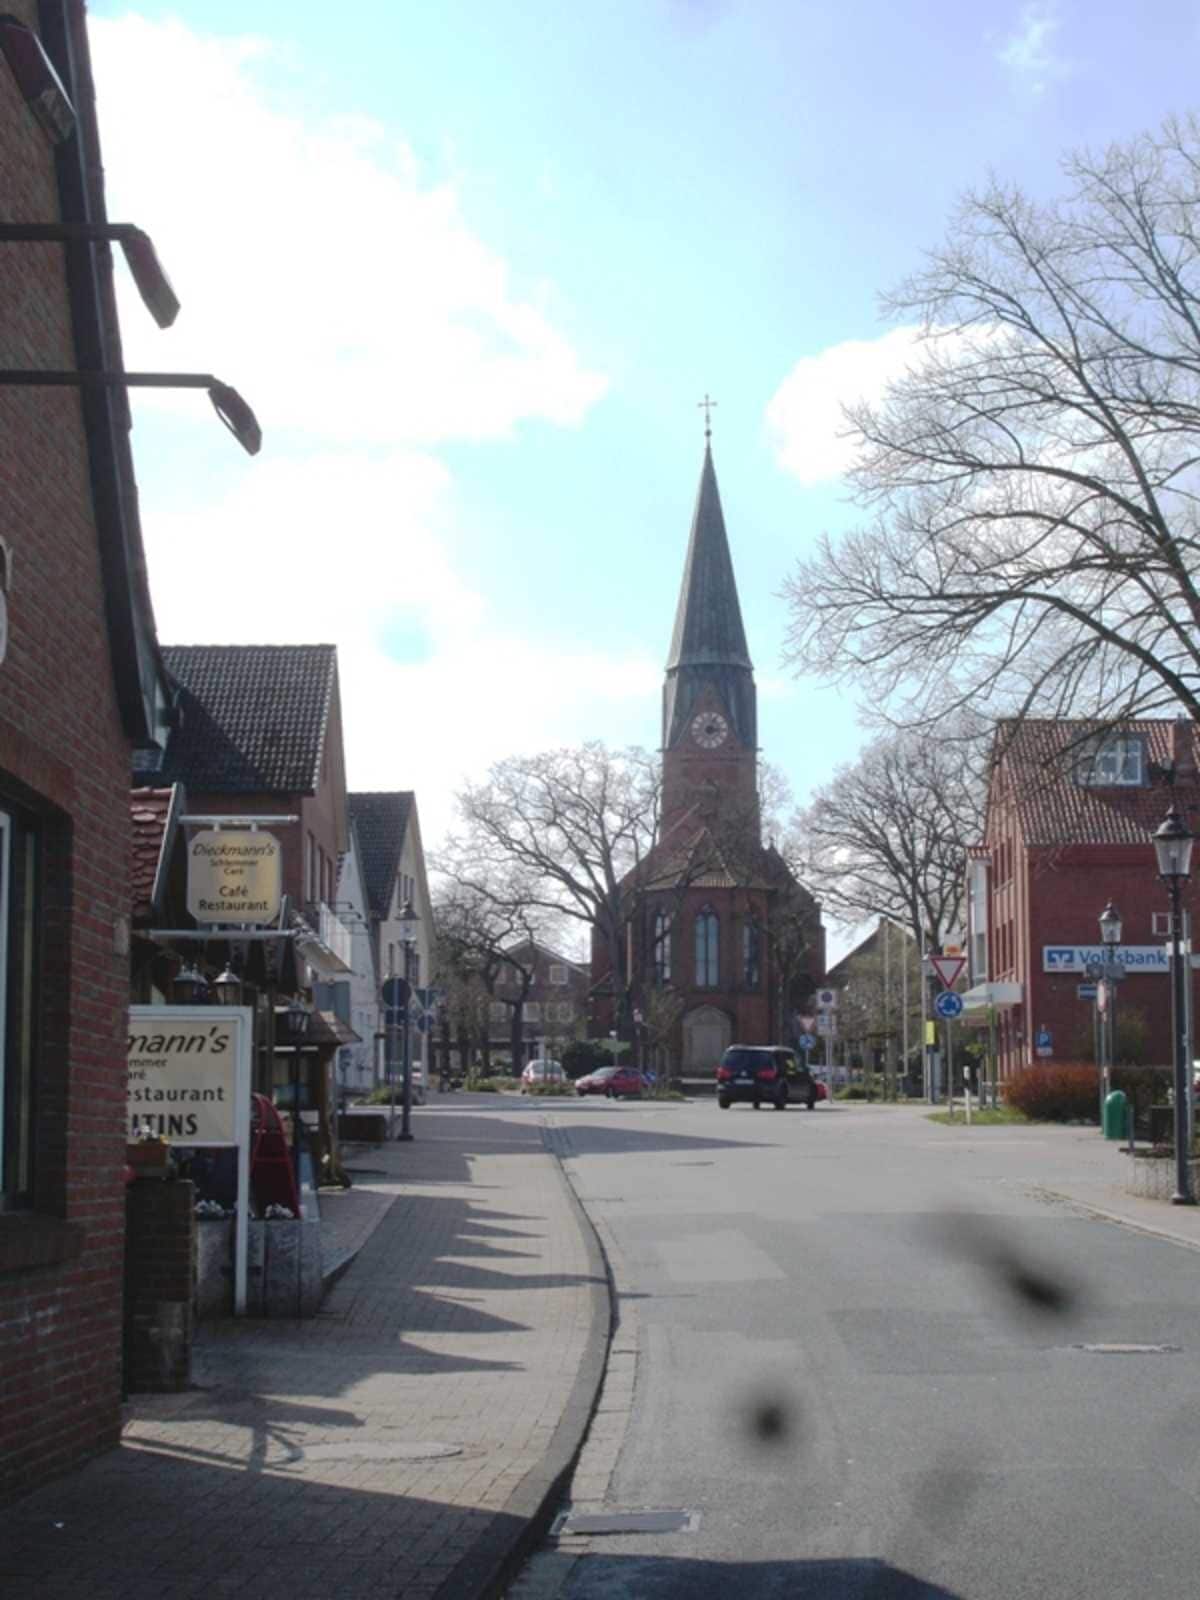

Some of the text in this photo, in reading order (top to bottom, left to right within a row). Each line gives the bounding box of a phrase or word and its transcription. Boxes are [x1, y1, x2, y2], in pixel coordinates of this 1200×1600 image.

[219, 884, 248, 897] Café
[198, 898, 269, 911] Restaurant
[1079, 949, 1168, 966] Volsbank
